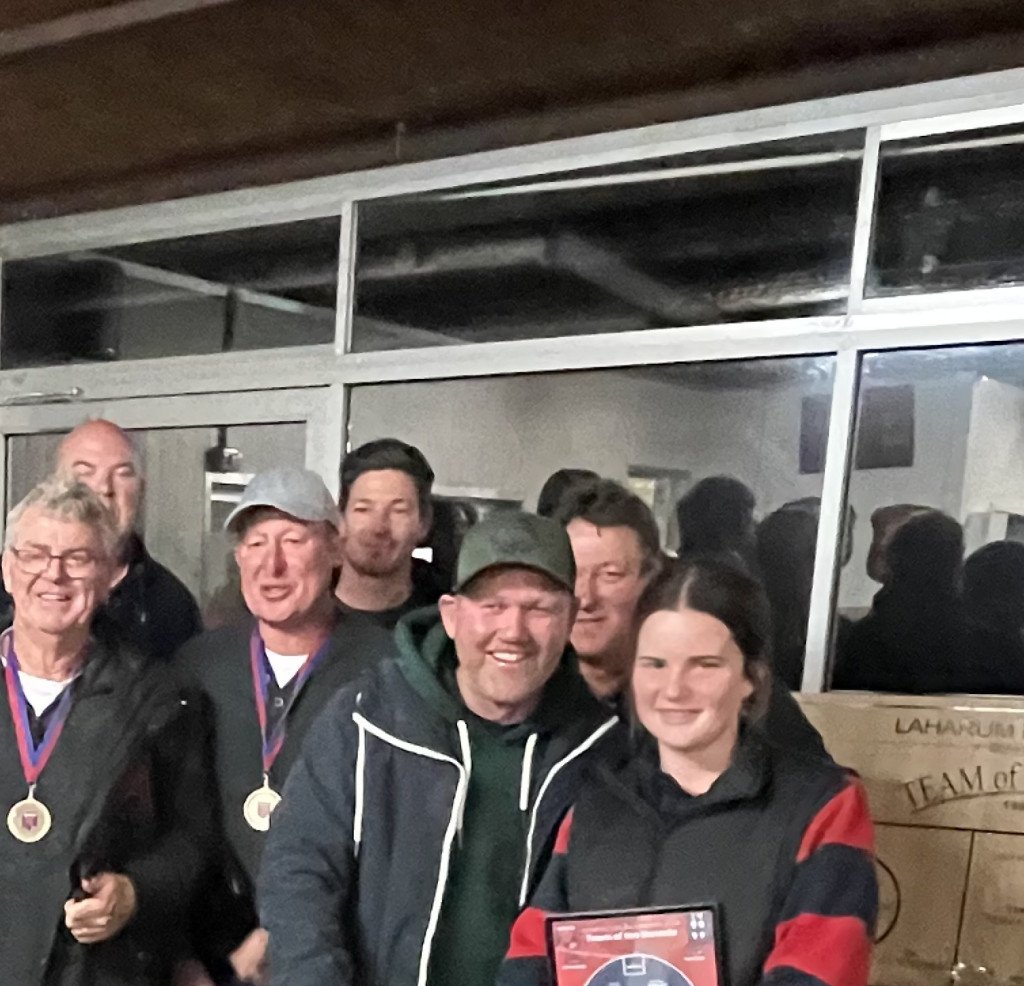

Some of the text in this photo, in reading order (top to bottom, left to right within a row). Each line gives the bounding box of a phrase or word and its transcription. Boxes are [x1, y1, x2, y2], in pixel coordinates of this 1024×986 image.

[895, 717, 1015, 738] LAHARUM
[904, 761, 1023, 812] TEAM of
